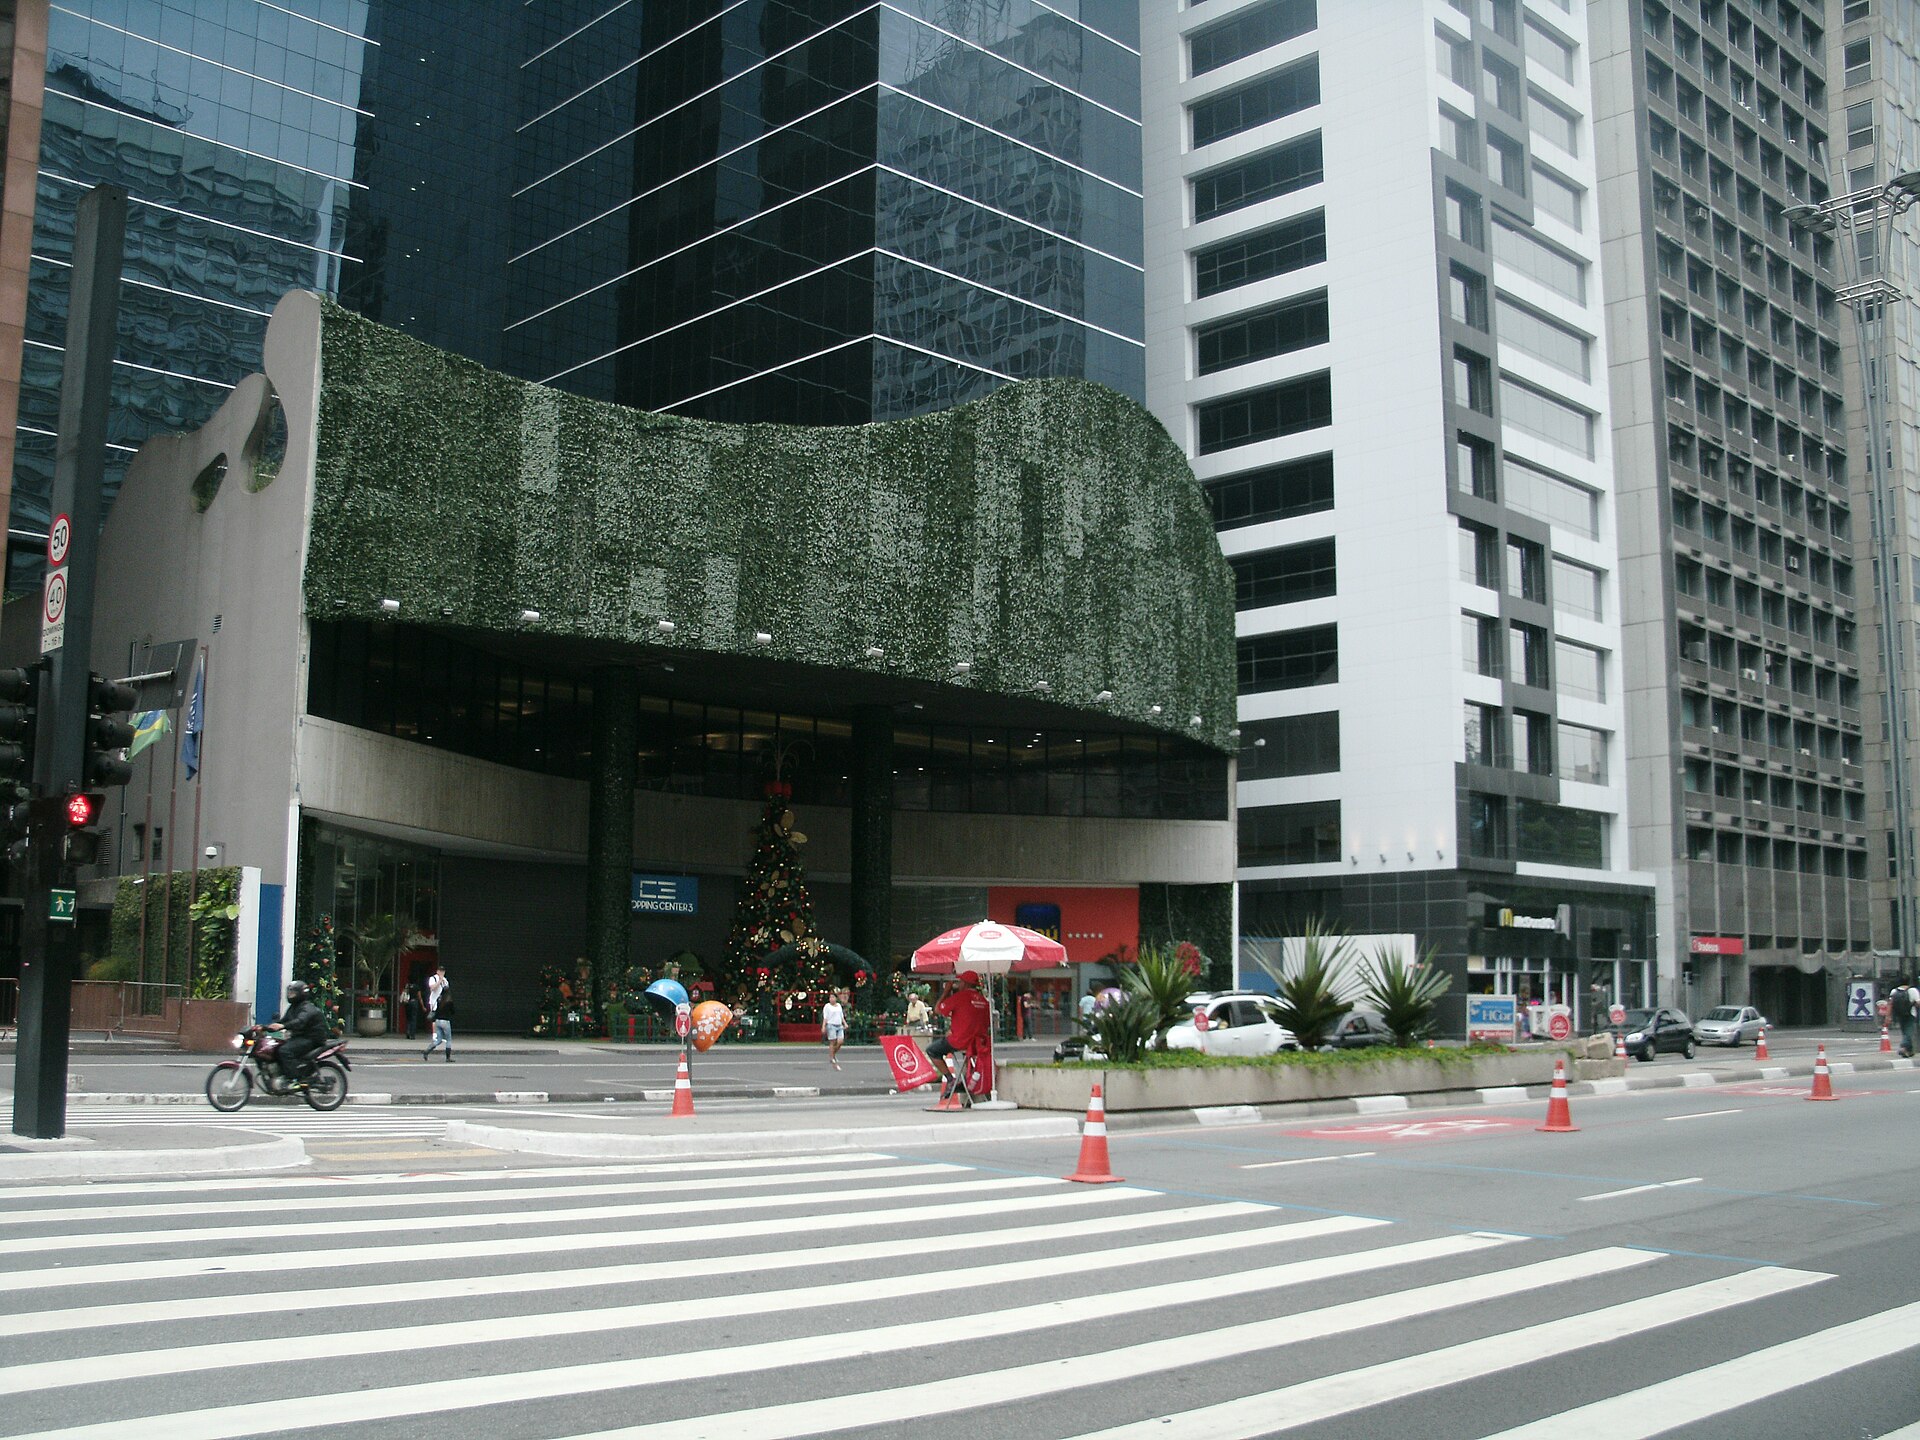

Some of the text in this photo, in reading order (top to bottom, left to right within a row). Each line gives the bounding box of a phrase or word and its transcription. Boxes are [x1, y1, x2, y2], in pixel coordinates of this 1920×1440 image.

[52, 525, 67, 550] 50
[49, 586, 63, 606] 40
[659, 901, 688, 911] CENTER
[688, 903, 693, 912] 3
[1482, 1009, 1511, 1021] HCor
